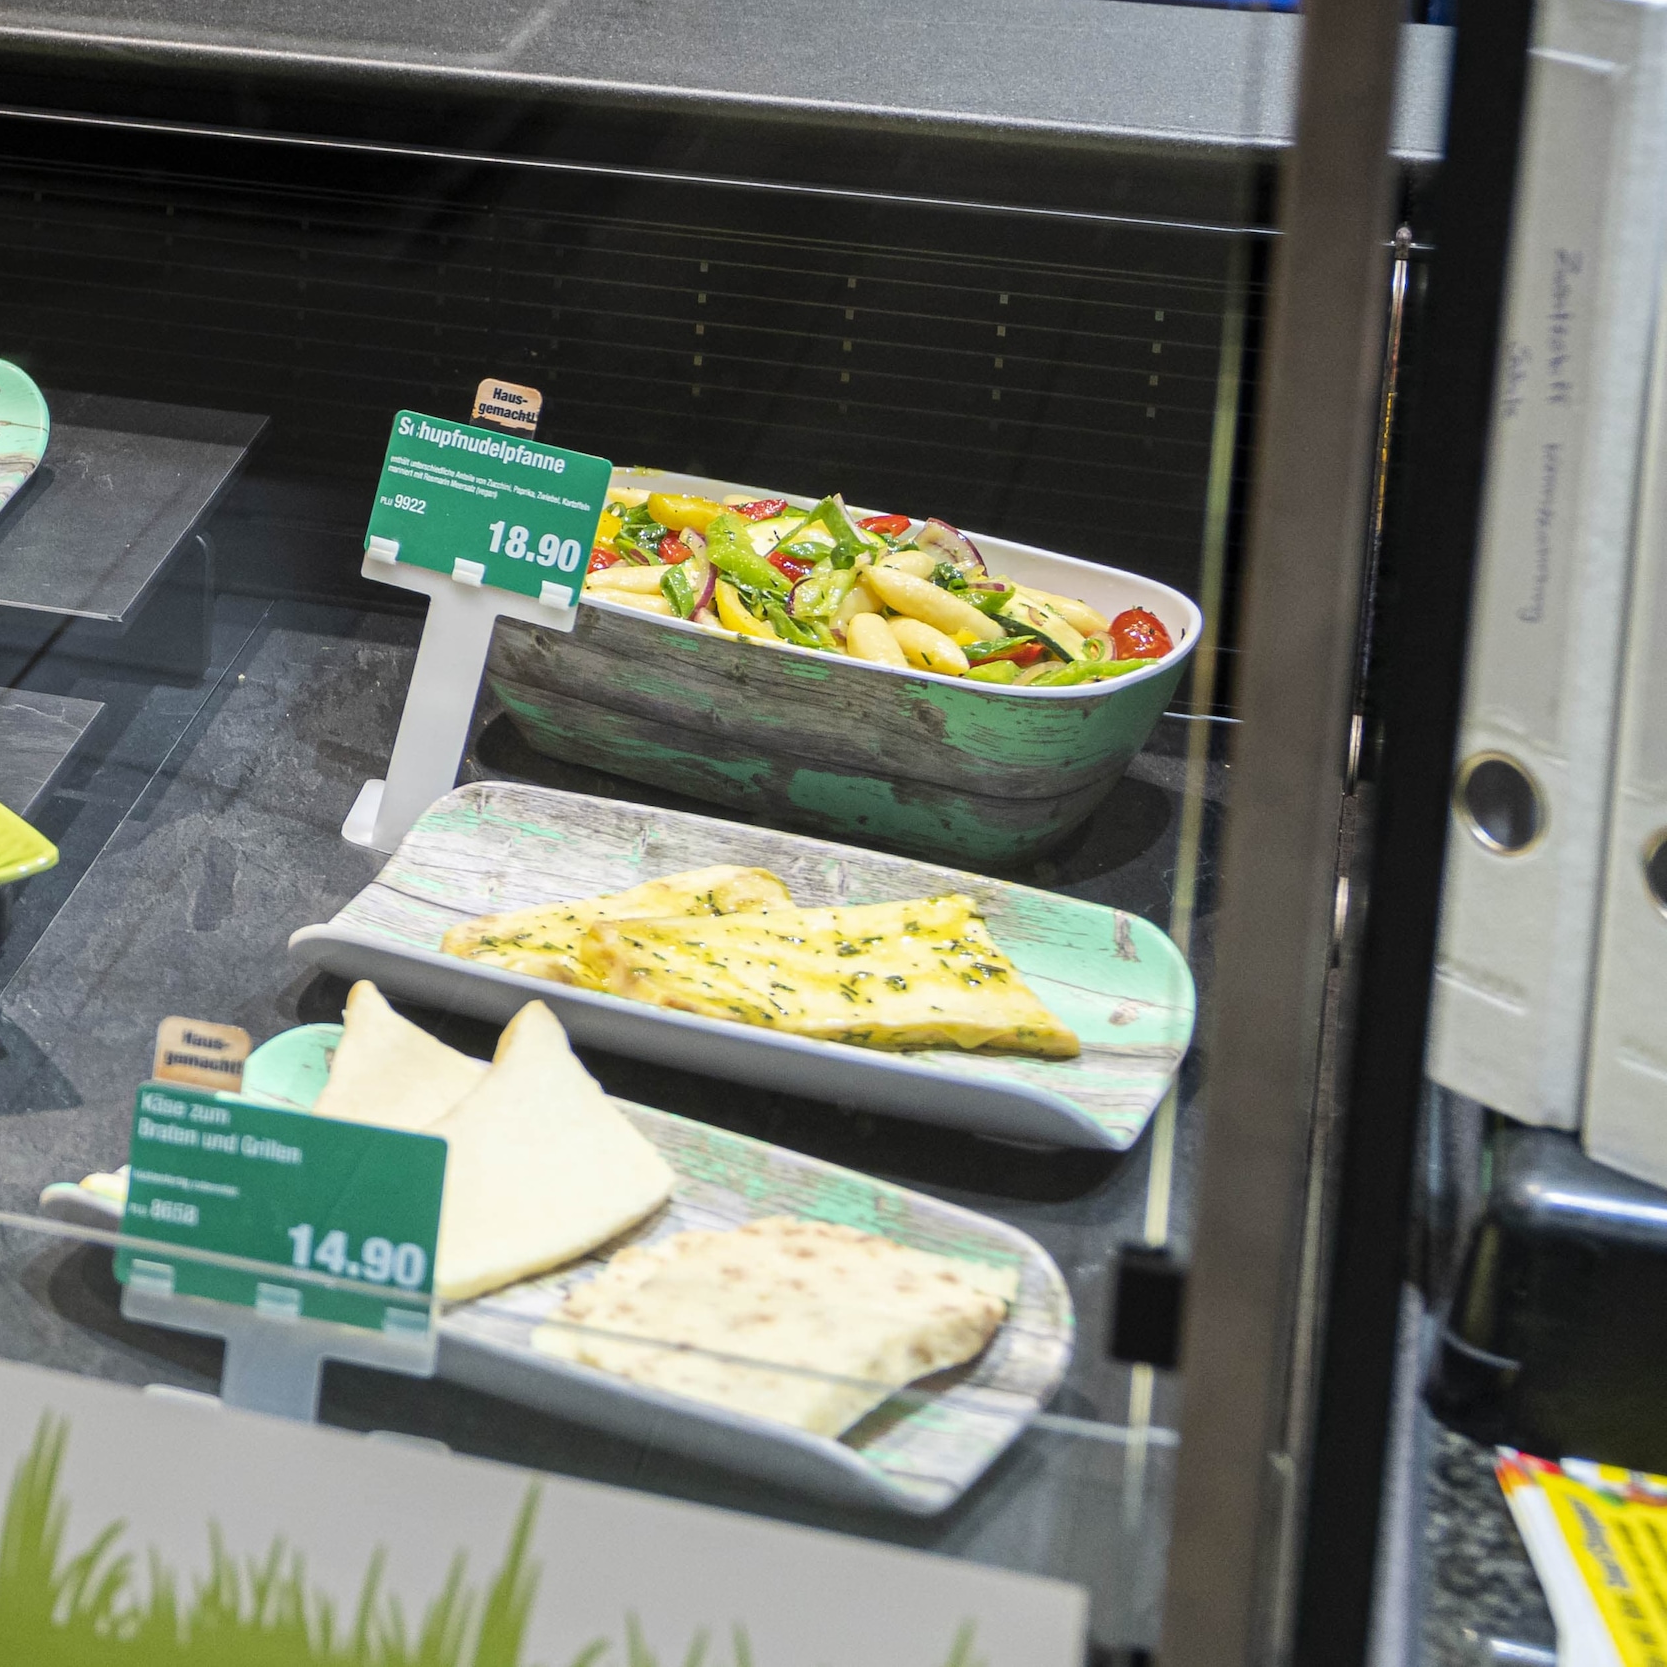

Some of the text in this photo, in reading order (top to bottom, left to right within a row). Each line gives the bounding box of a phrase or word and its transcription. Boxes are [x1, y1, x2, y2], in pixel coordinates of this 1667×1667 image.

[492, 387, 529, 405] Haus-
[380, 494, 427, 515] PLU 9922
[488, 520, 581, 572] 18.90
[182, 1029, 230, 1051] Haus-
[164, 1049, 245, 1075] gemacht!
[141, 1092, 232, 1126] Käse zum
[137, 1118, 303, 1166] Braten und Grillen
[287, 1223, 427, 1290] 14.90
